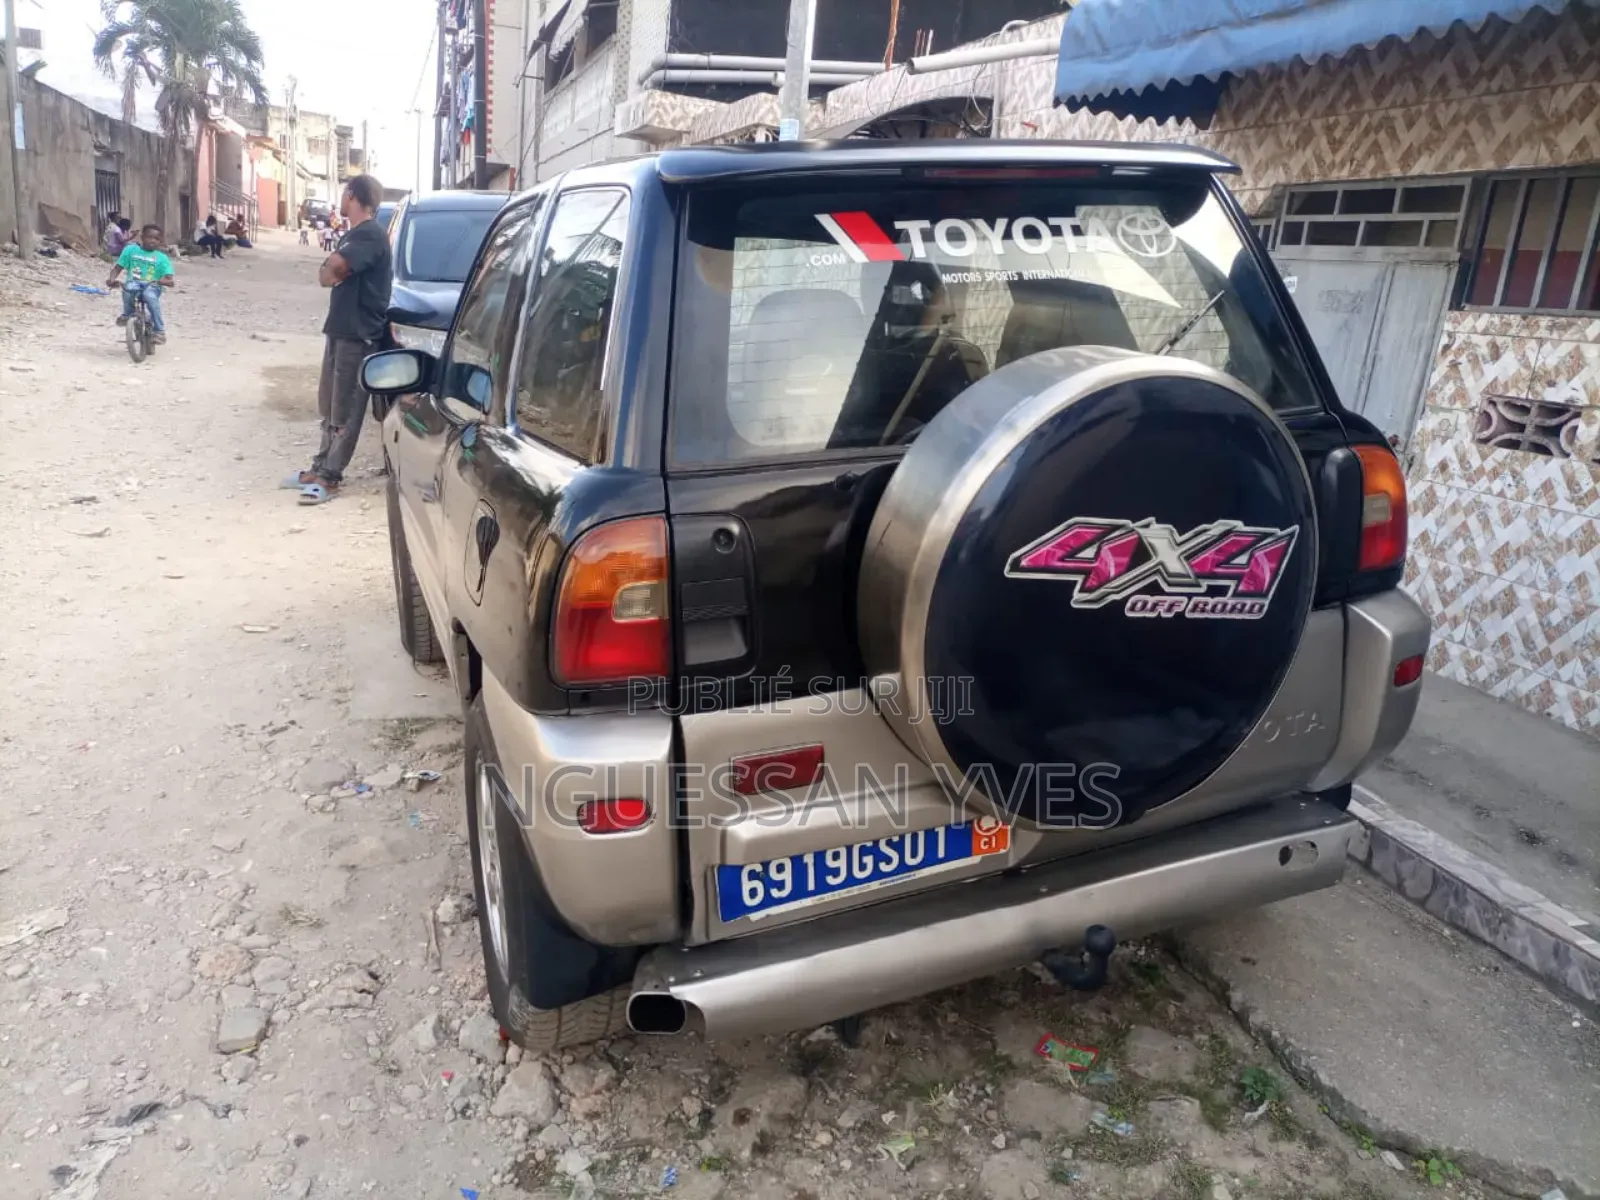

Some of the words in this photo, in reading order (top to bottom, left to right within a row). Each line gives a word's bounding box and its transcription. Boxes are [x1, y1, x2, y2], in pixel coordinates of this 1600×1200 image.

[894, 216, 1114, 260] TOYOTA
[942, 271, 982, 285] MOTORS
[984, 269, 1019, 282] SPORTS
[1125, 595, 1187, 617] OFF
[1185, 597, 1268, 619] ROAD
